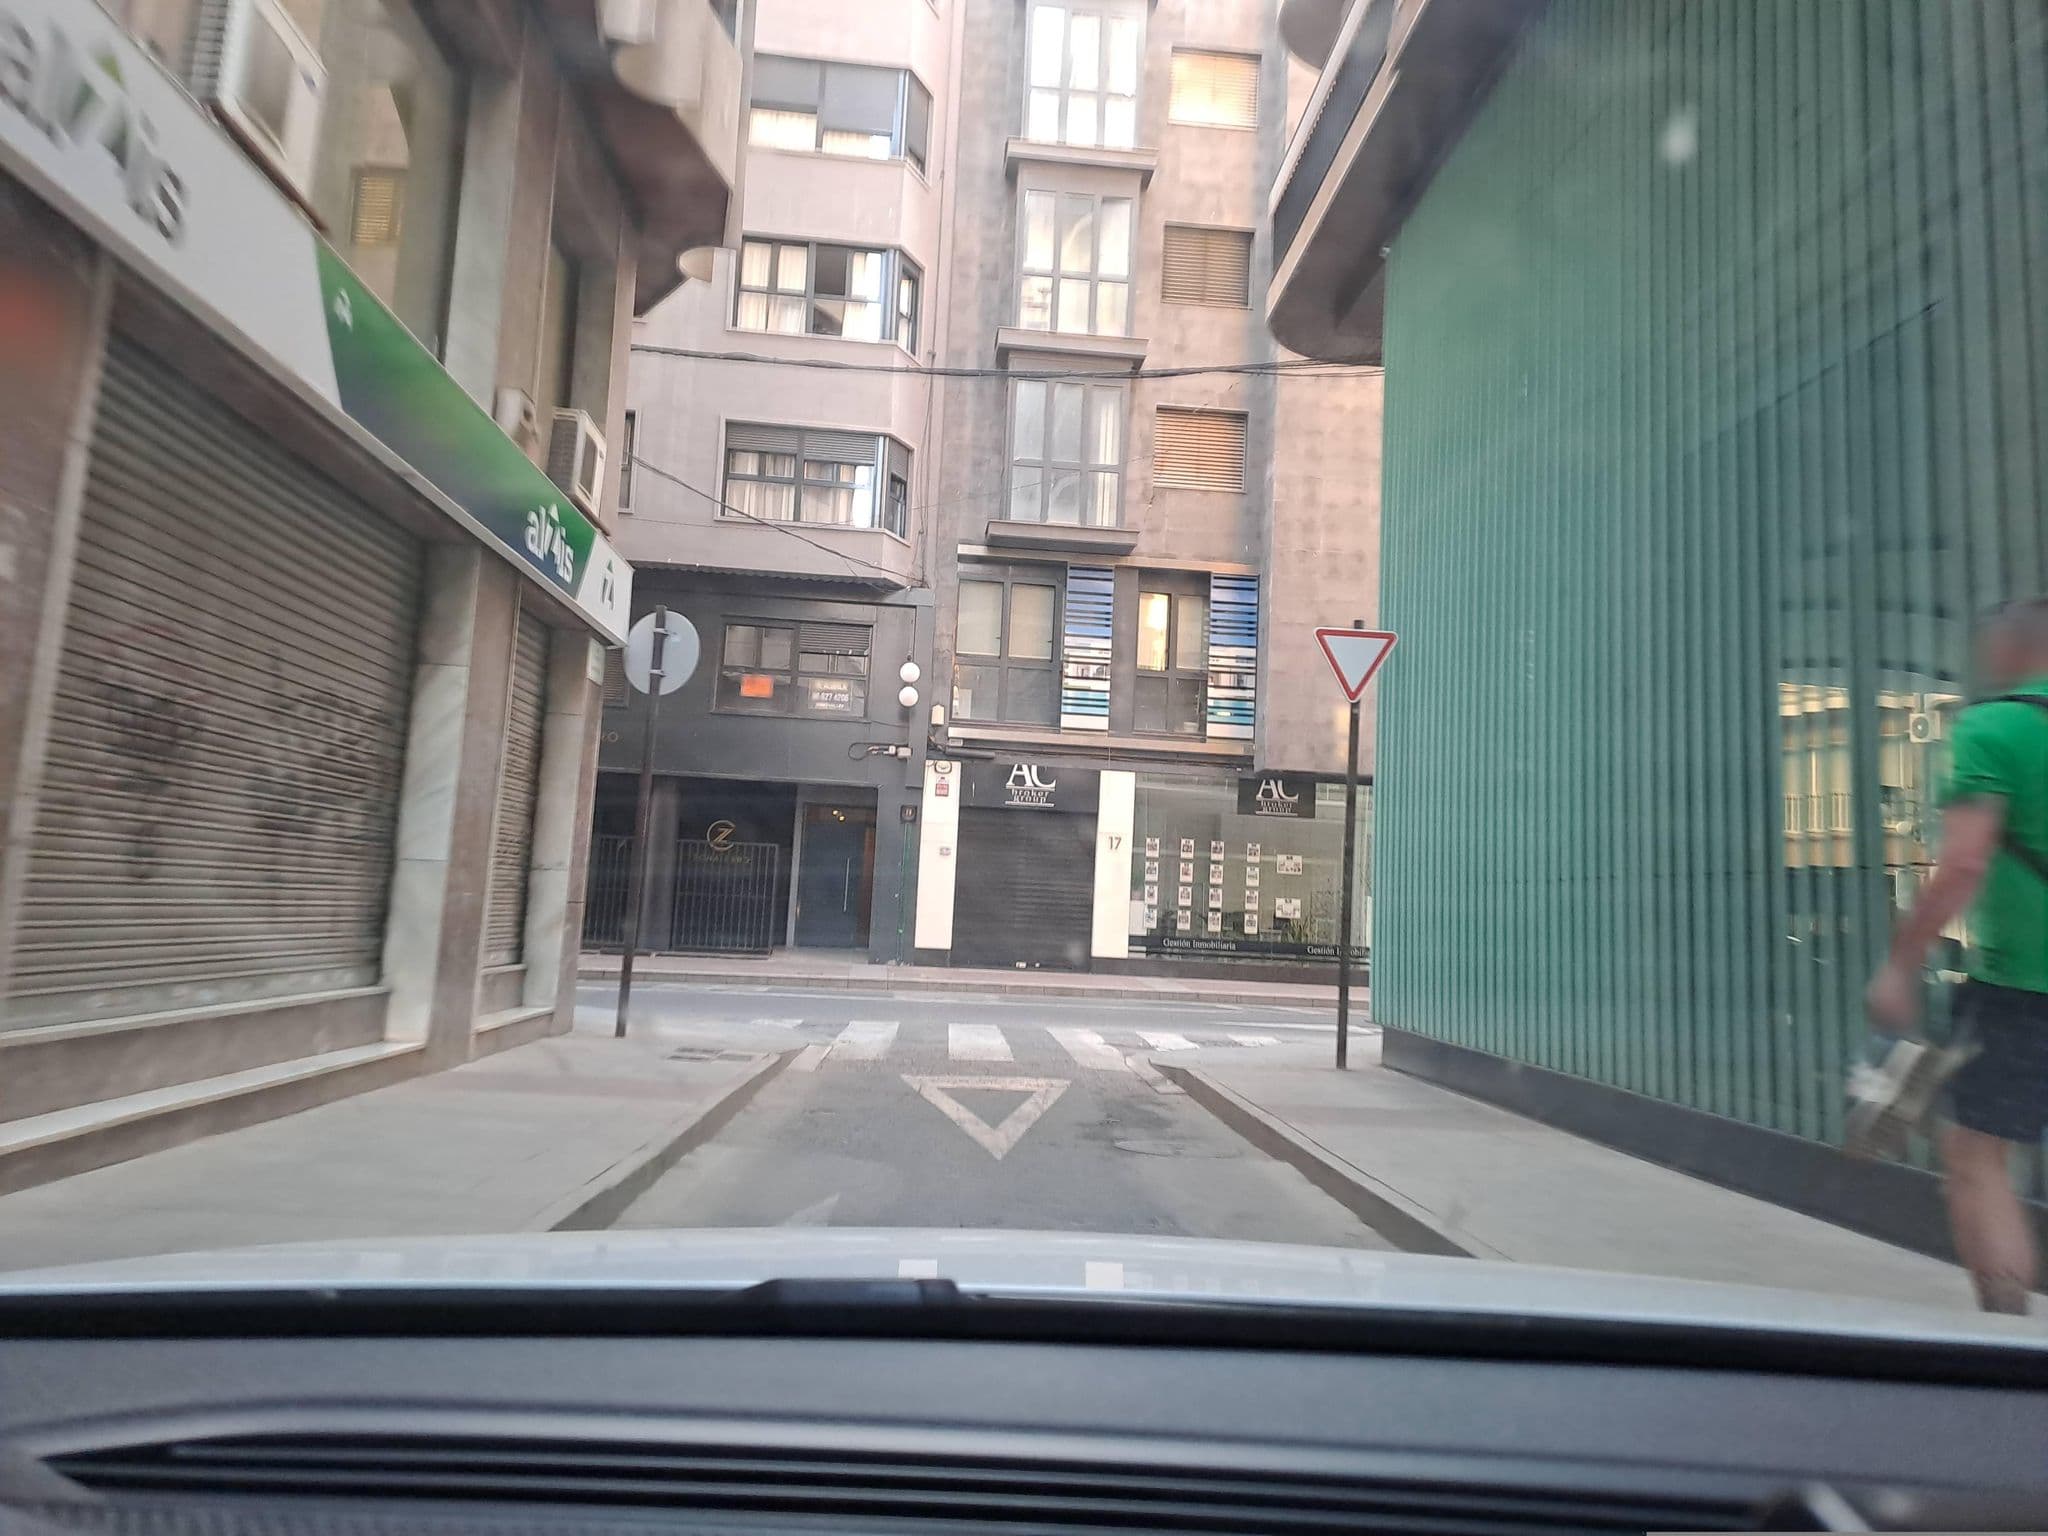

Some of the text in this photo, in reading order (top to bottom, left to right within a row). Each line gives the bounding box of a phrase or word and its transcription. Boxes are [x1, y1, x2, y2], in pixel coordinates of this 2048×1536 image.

[1005, 763, 1056, 788] AC
[1108, 836, 1121, 850] 17
[1163, 937, 1236, 951] Gestión Inmobiliaria
[1307, 945, 1334, 956] Gestión
